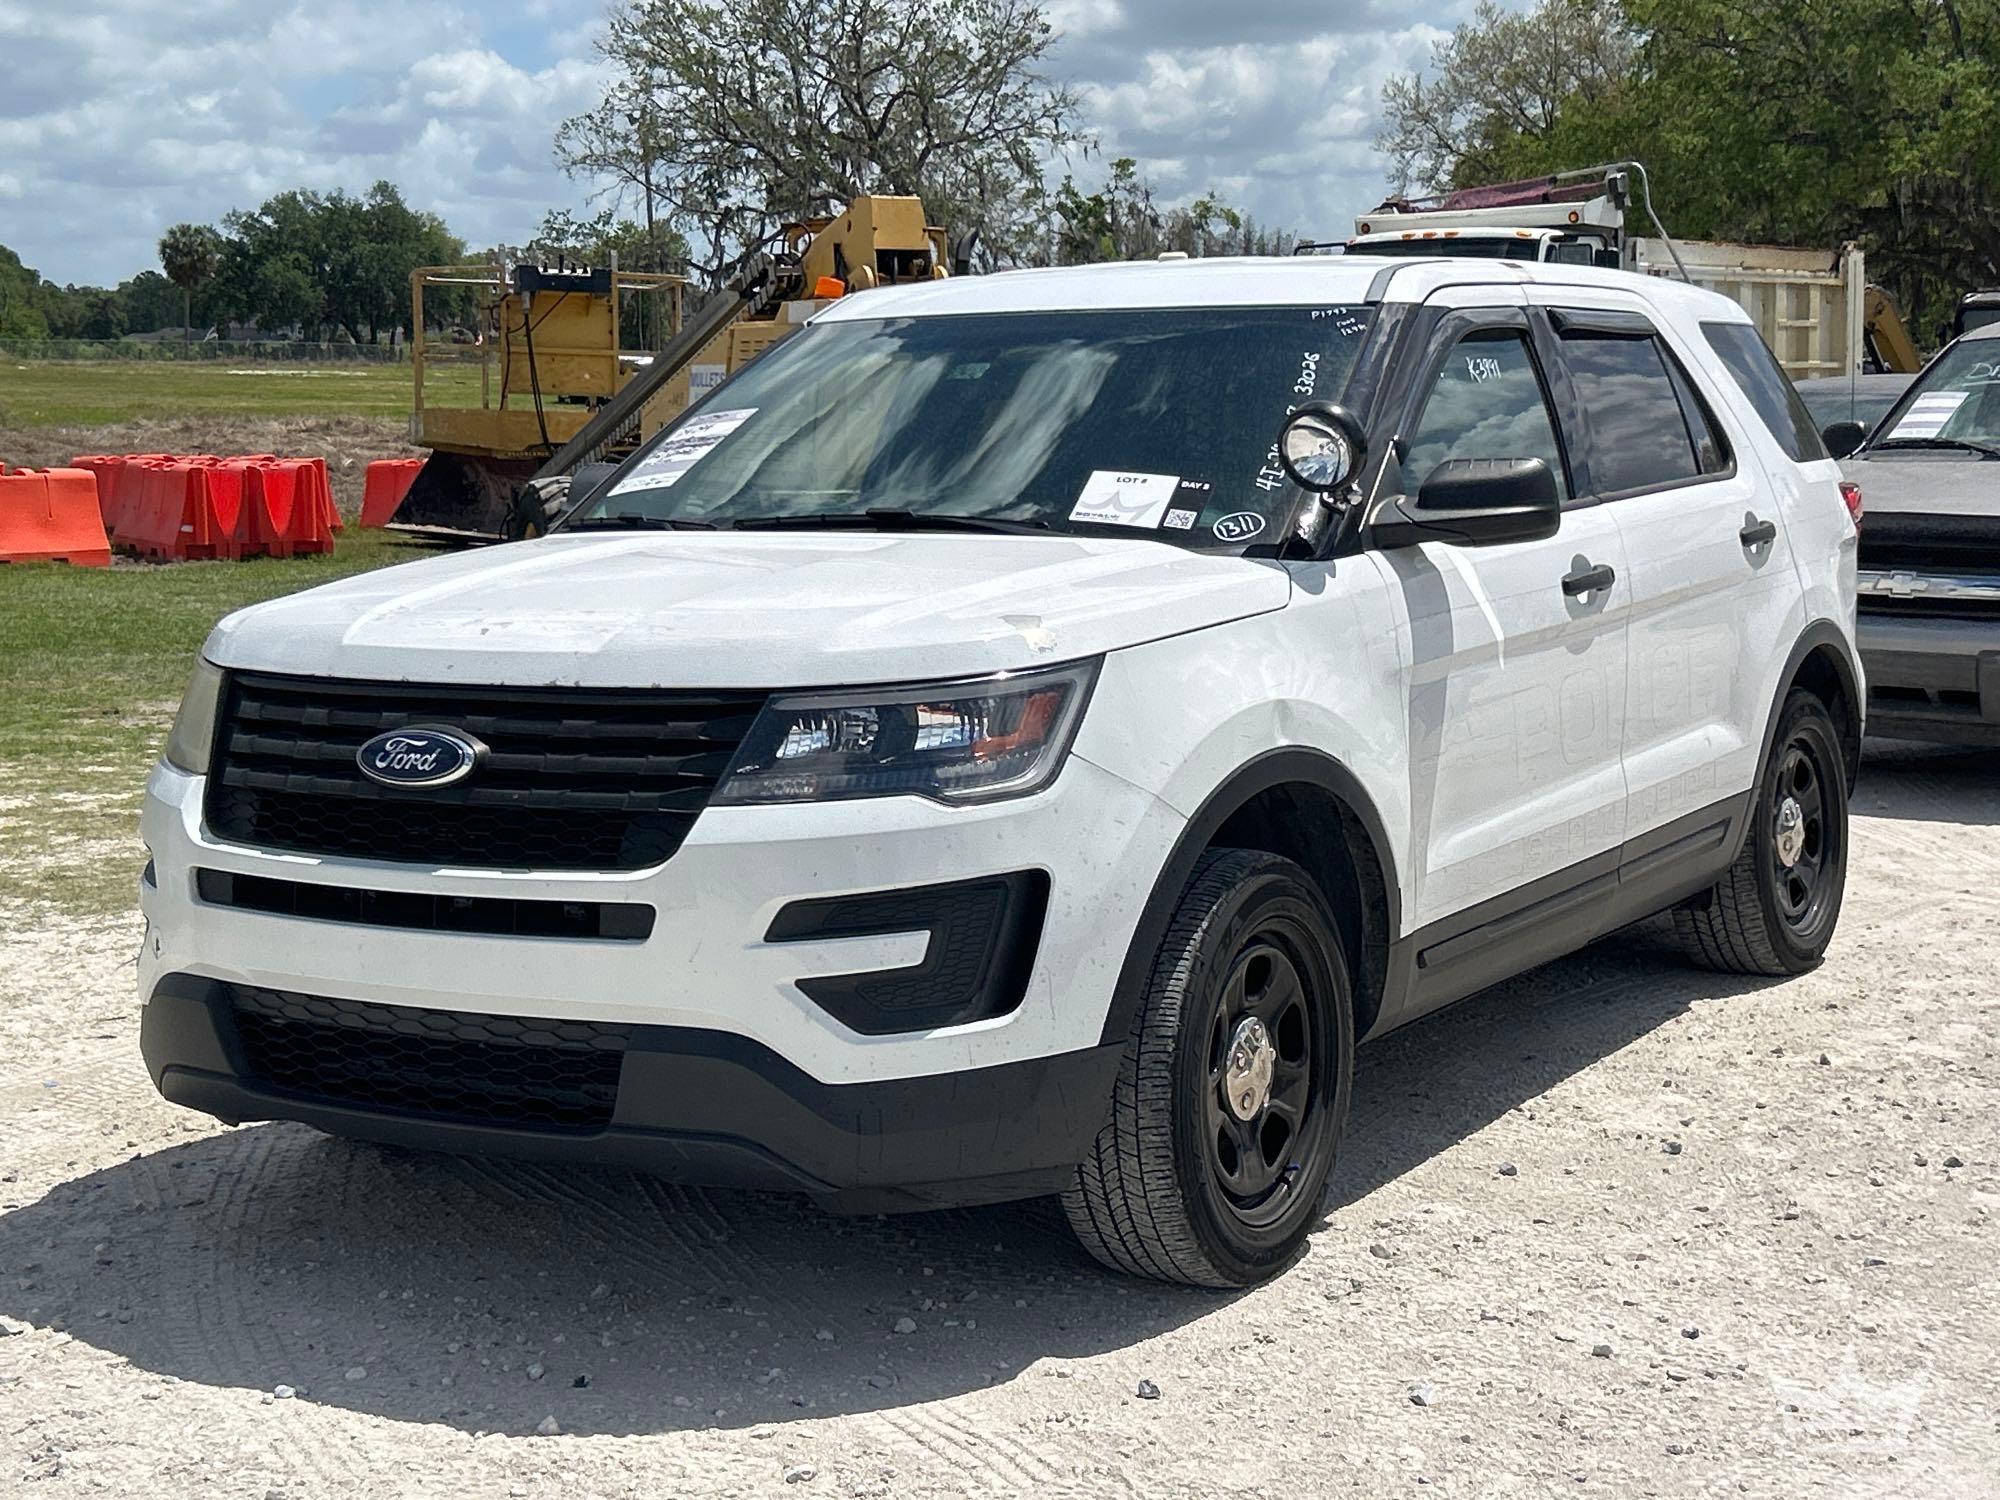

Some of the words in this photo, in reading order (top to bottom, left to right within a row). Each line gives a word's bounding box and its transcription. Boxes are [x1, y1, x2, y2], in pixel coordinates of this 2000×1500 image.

[1293, 351, 1321, 396] 33026
[1116, 476, 1139, 484] LOT
[1181, 480, 1203, 491] DAY
[1218, 515, 1255, 538] 1311
[375, 737, 442, 771] Ford
